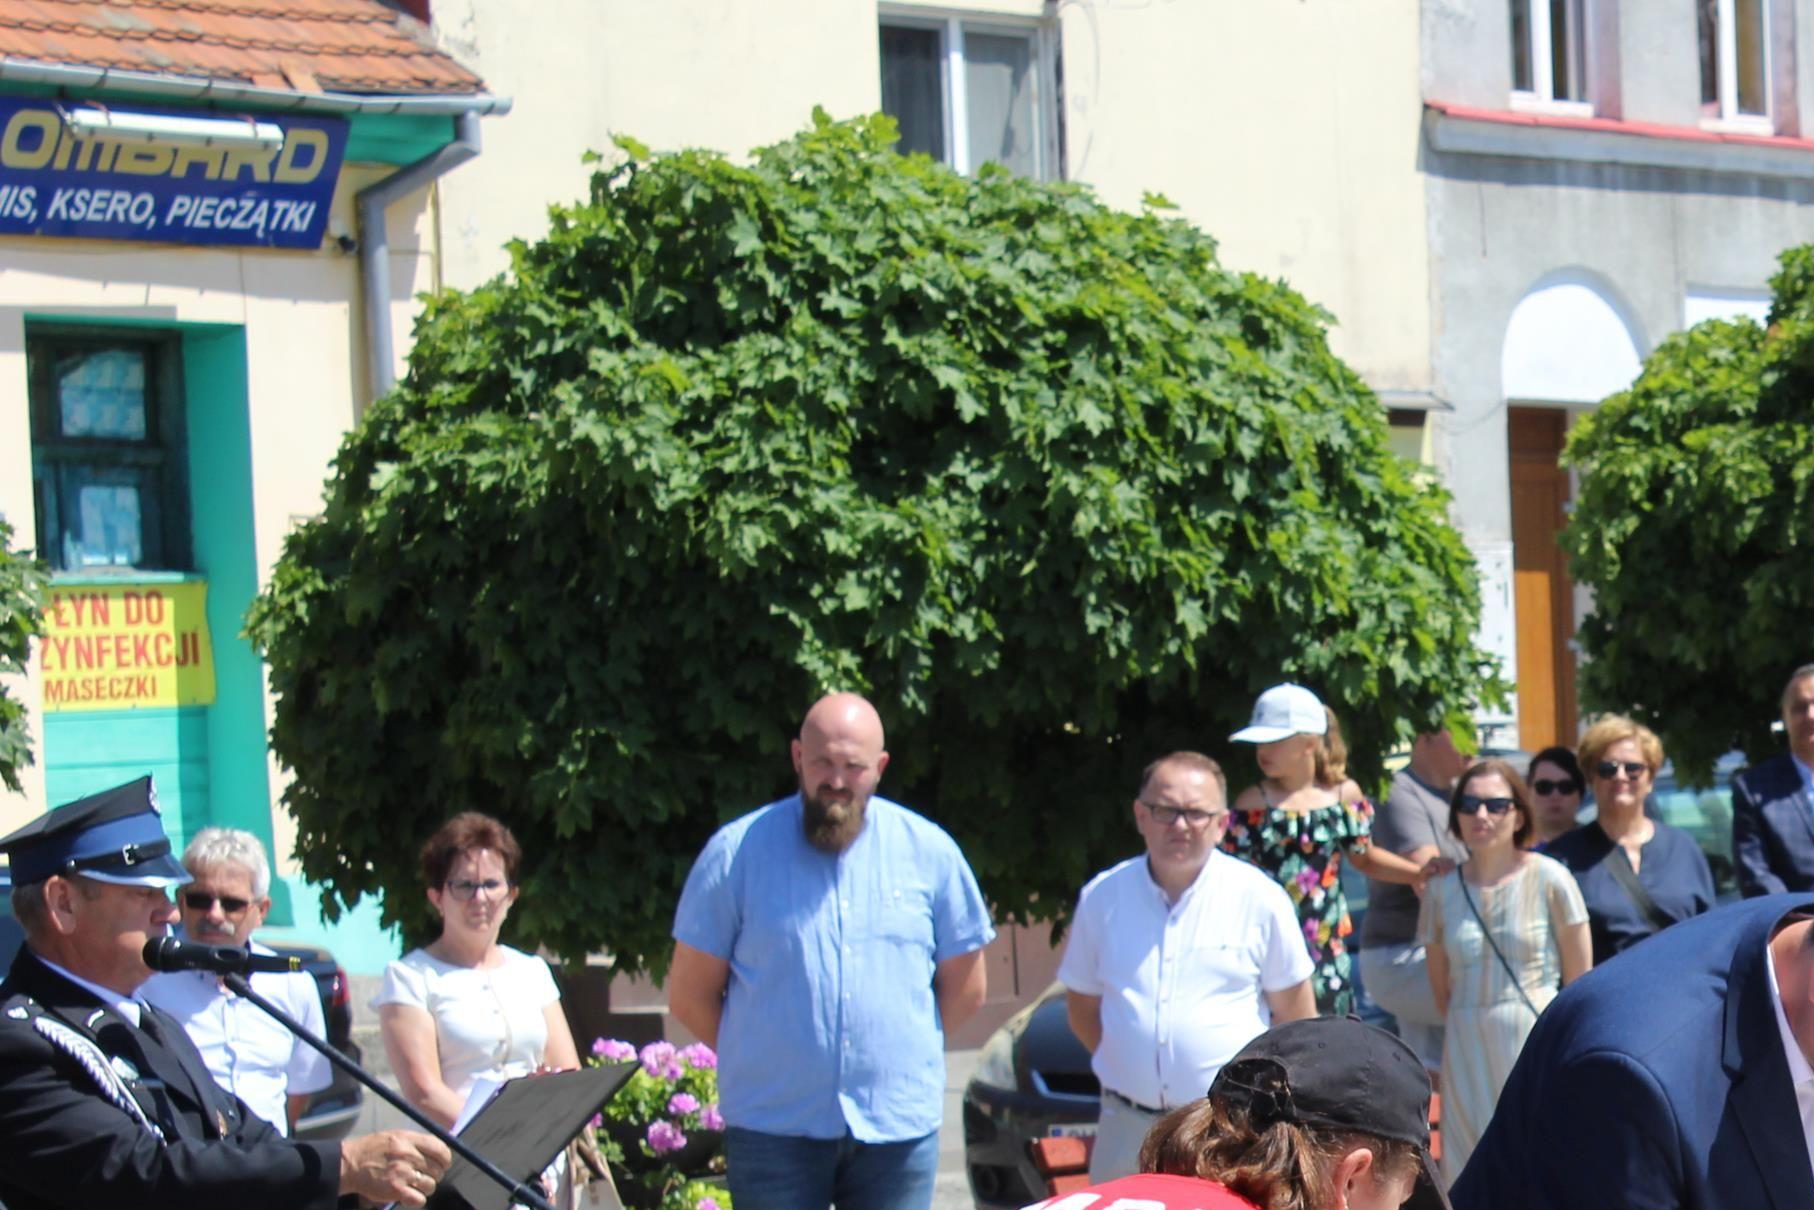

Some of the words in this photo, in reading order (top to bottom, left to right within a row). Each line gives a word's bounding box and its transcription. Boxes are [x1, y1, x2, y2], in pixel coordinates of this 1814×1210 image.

[46, 187, 157, 231] KSERO,
[41, 590, 110, 628] ŁYN
[123, 589, 164, 627] DO
[44, 674, 157, 704] MASECZKI
